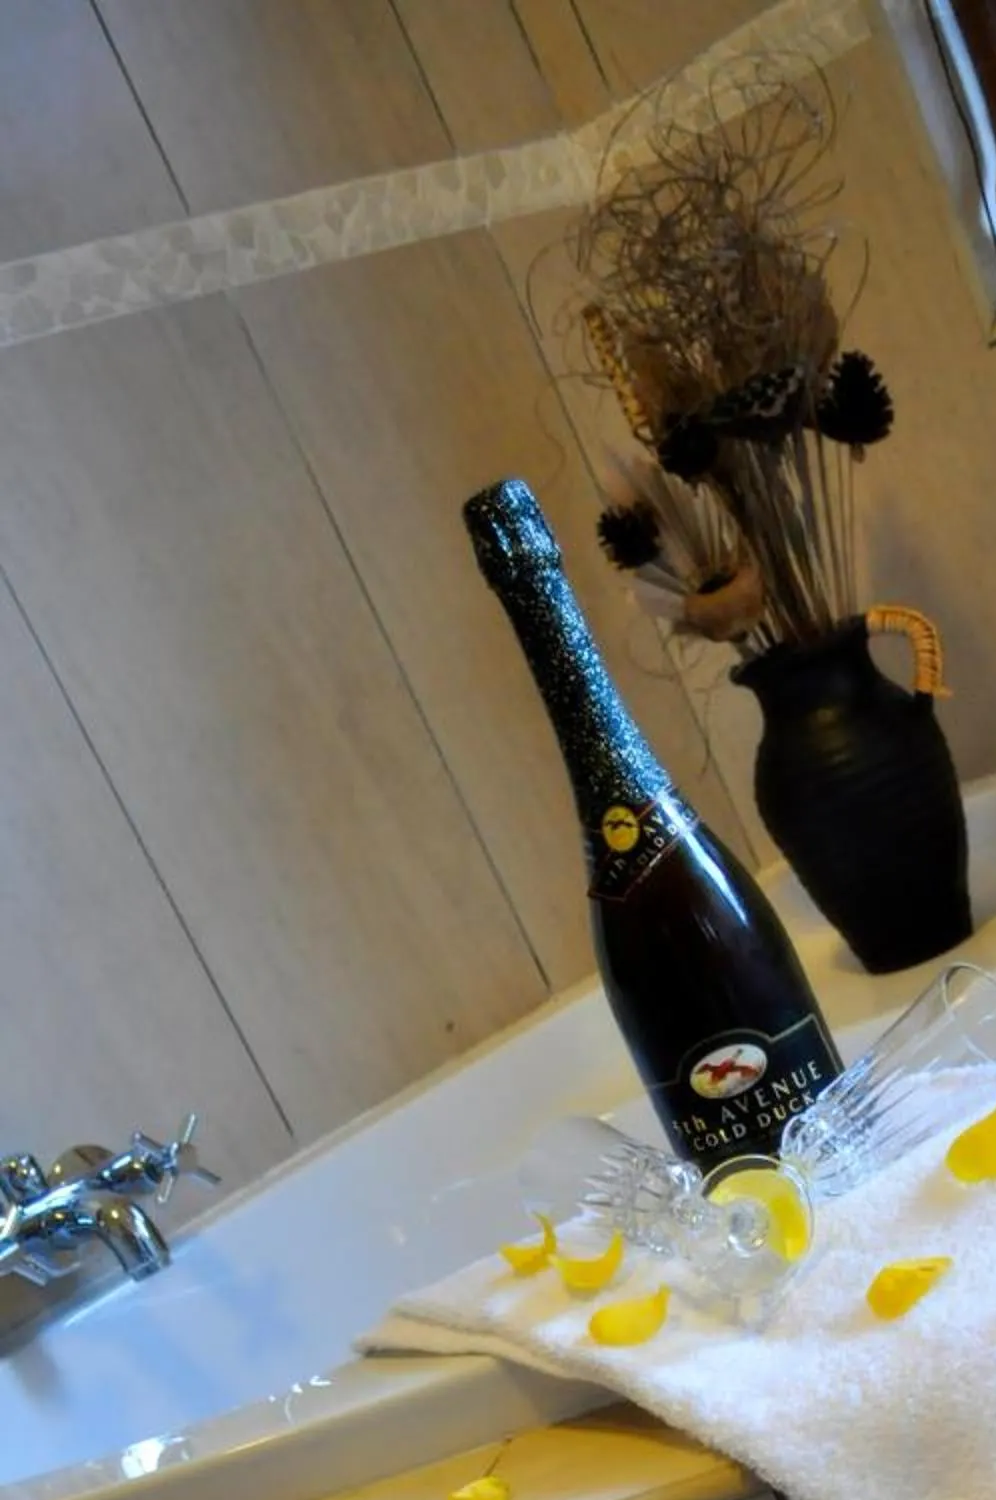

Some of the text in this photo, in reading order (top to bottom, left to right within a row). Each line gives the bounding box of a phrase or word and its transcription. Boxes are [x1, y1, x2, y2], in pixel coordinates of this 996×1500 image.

[693, 1090, 817, 1152] COLD DUCK
[720, 1059, 824, 1125] AVENUE
